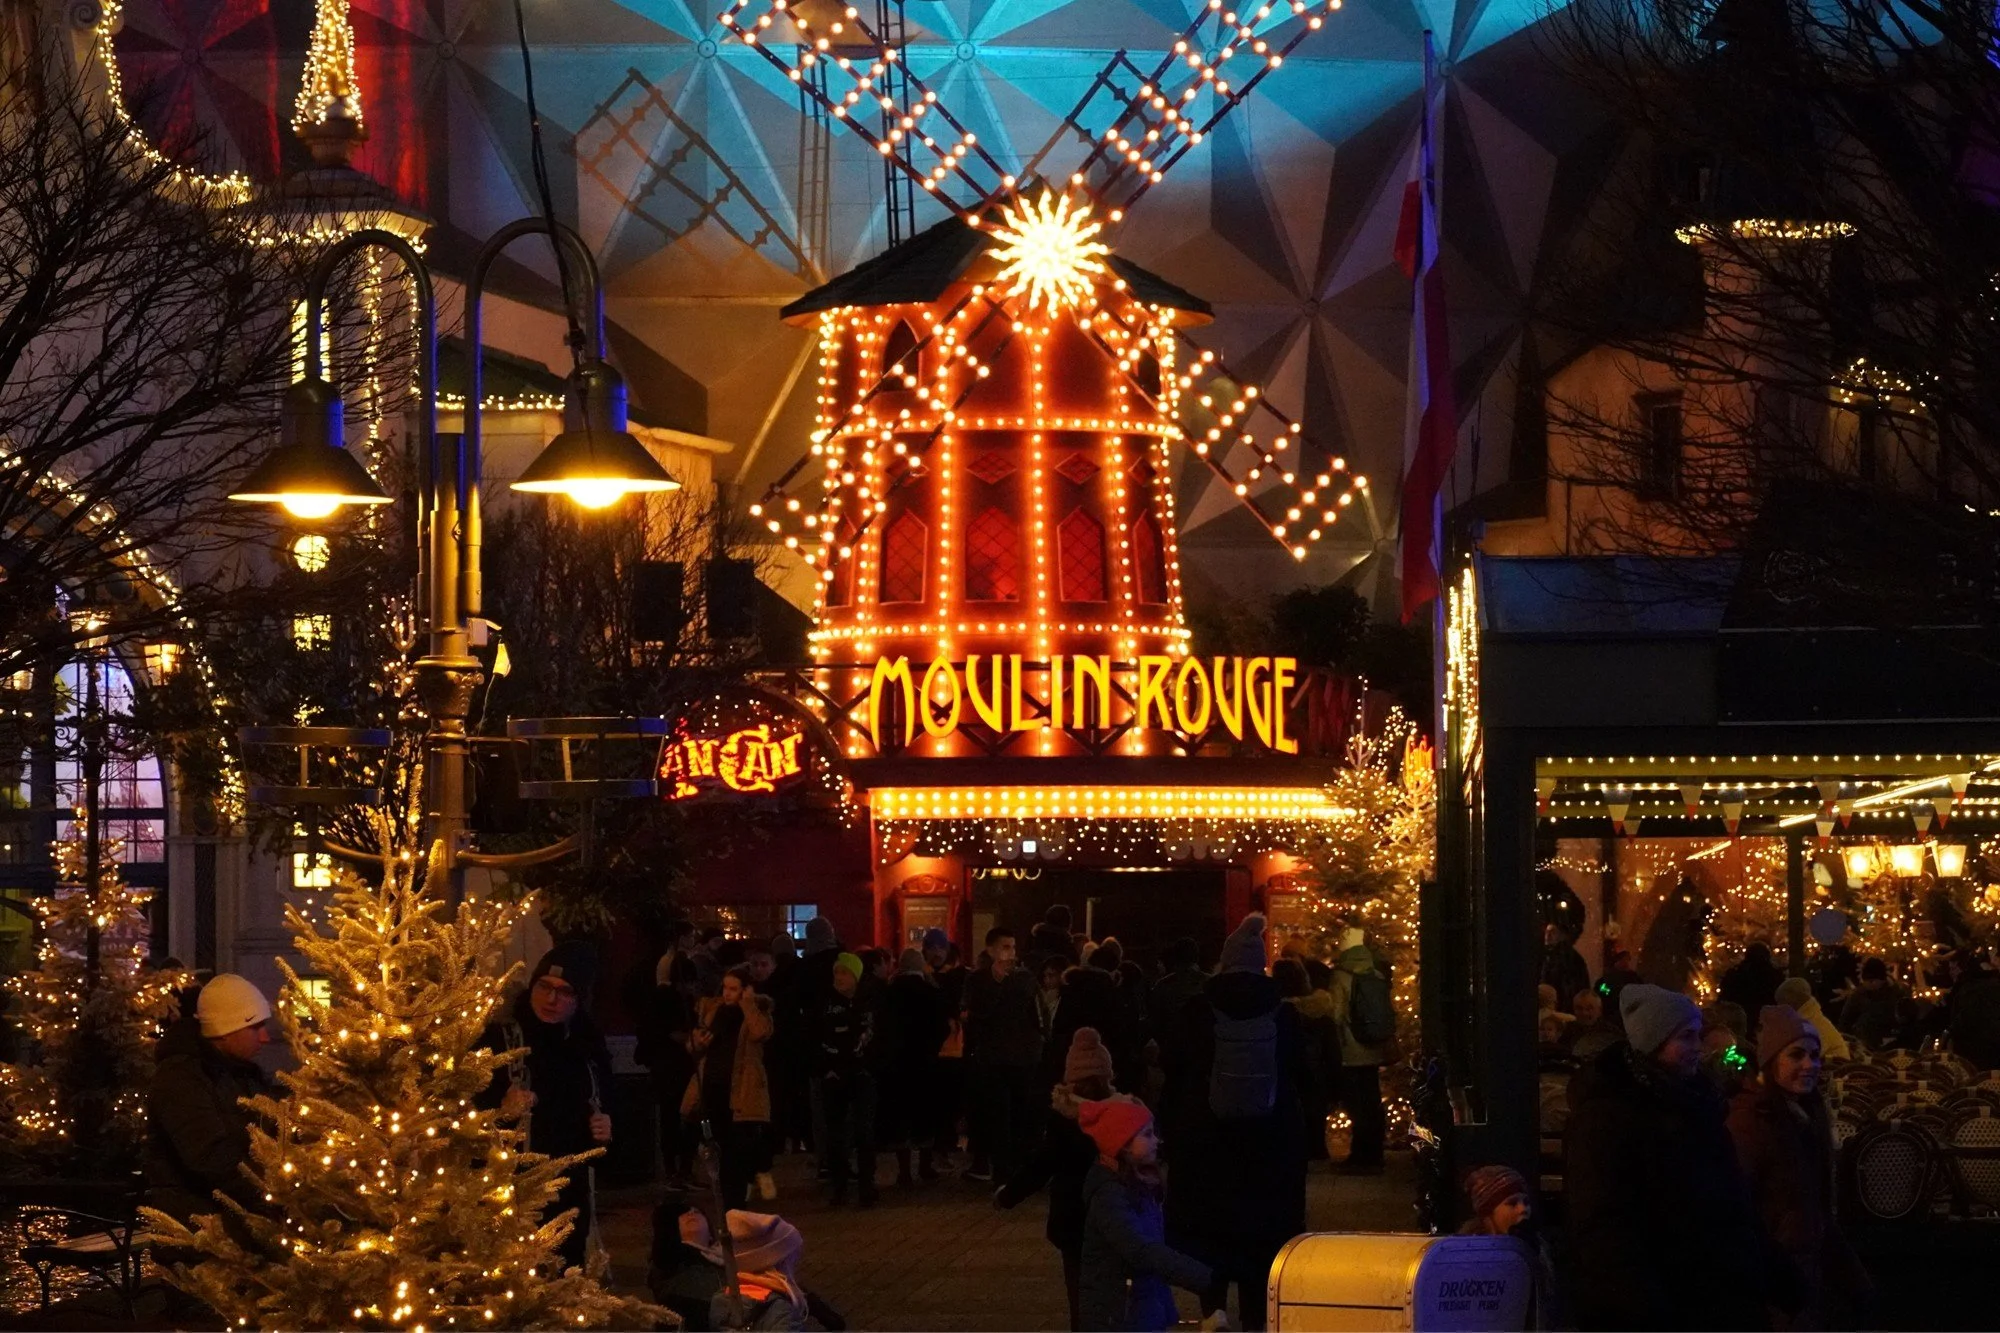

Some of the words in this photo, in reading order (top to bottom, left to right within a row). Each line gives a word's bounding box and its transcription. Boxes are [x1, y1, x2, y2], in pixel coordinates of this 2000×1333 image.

[869, 655, 1111, 753] MOULIN
[1139, 656, 1299, 755] ROUGE
[718, 724, 803, 793] CAN
